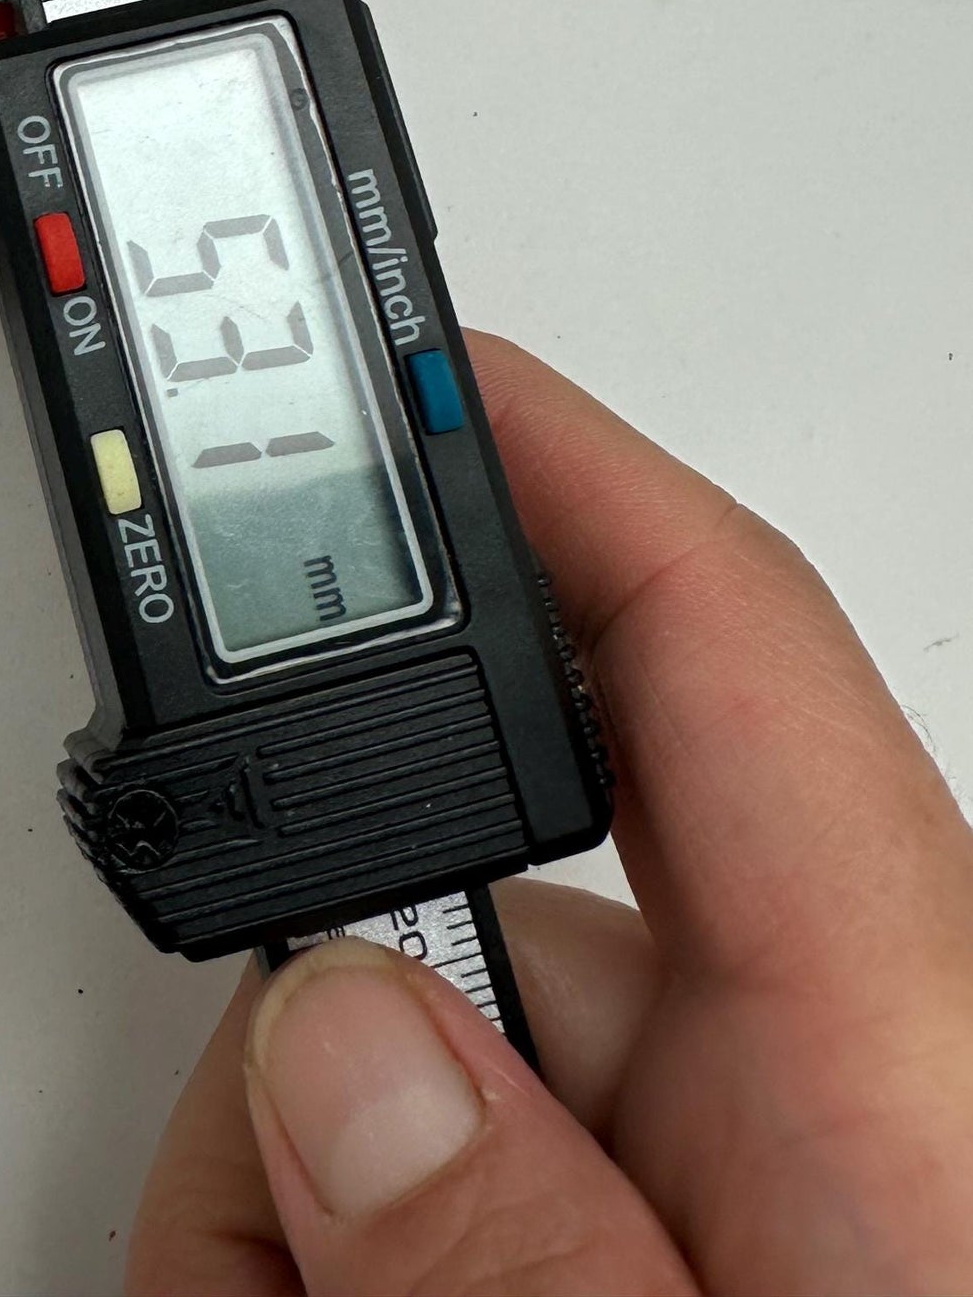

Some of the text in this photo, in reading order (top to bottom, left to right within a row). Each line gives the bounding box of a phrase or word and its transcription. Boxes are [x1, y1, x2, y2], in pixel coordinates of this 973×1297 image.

[16, 115, 64, 190] OFF
[346, 168, 428, 347] mm/inch
[62, 295, 107, 358] ON
[117, 513, 175, 625] ZERO
[303, 554, 347, 623] mm
